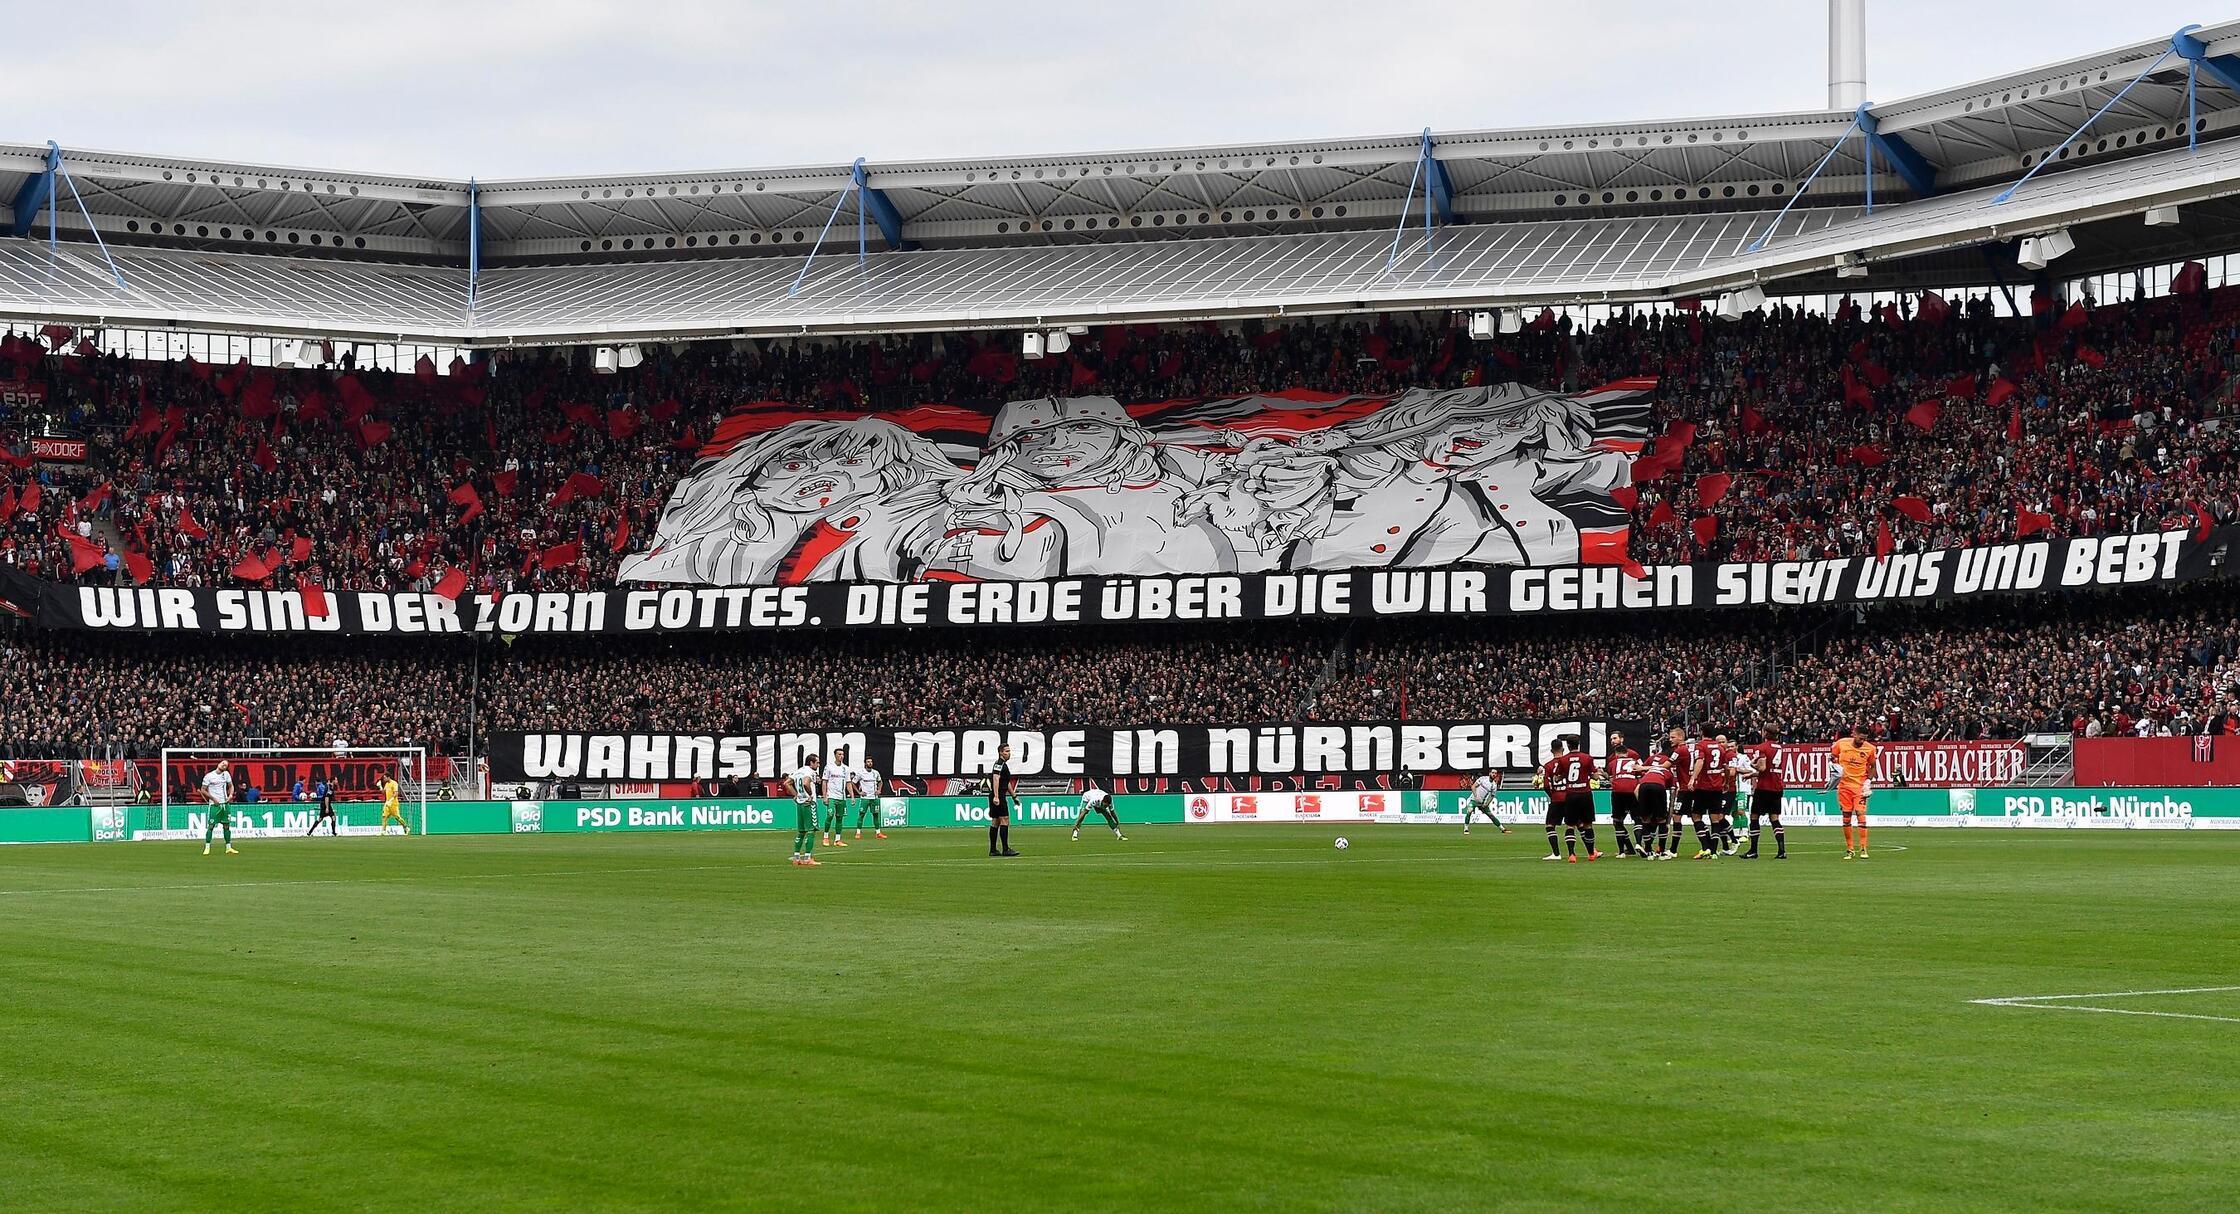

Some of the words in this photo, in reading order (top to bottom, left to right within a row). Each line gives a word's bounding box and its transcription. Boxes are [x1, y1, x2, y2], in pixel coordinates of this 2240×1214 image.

[79, 586, 200, 629] WIR
[216, 589, 341, 631] SIND
[358, 592, 461, 633] DER
[474, 591, 606, 633] ZORN
[624, 586, 822, 630] GOTTES.
[845, 583, 930, 625] DIE
[947, 580, 1082, 625] ERDE
[1101, 577, 1243, 620] ÜBER
[1264, 573, 1352, 616] DIE
[1372, 570, 1487, 614] WIR
[1510, 565, 1693, 612] GEHEN
[1715, 557, 1851, 605] SIEHT
[1855, 550, 1944, 599] UNS
[1953, 541, 2050, 595] UND
[2060, 528, 2190, 586] BEBT
[522, 733, 868, 780] WAHNSINN
[892, 729, 1086, 777] MADE
[1111, 728, 1180, 775] IN
[1207, 720, 1608, 773] NÜRNBERG!
[1709, 748, 1721, 769] 3
[1772, 749, 1782, 768] 4
[137, 764, 253, 793] BANA
[1567, 762, 1581, 782] 6
[576, 806, 622, 828] PSD
[628, 804, 685, 827] Bank
[691, 801, 774, 826] Nürnbe
[2004, 796, 2045, 817] PSD
[2050, 796, 2104, 817] Bank
[2109, 796, 2193, 817] Nürnbe
[514, 821, 541, 833] Bank
[883, 816, 907, 827] Bank
